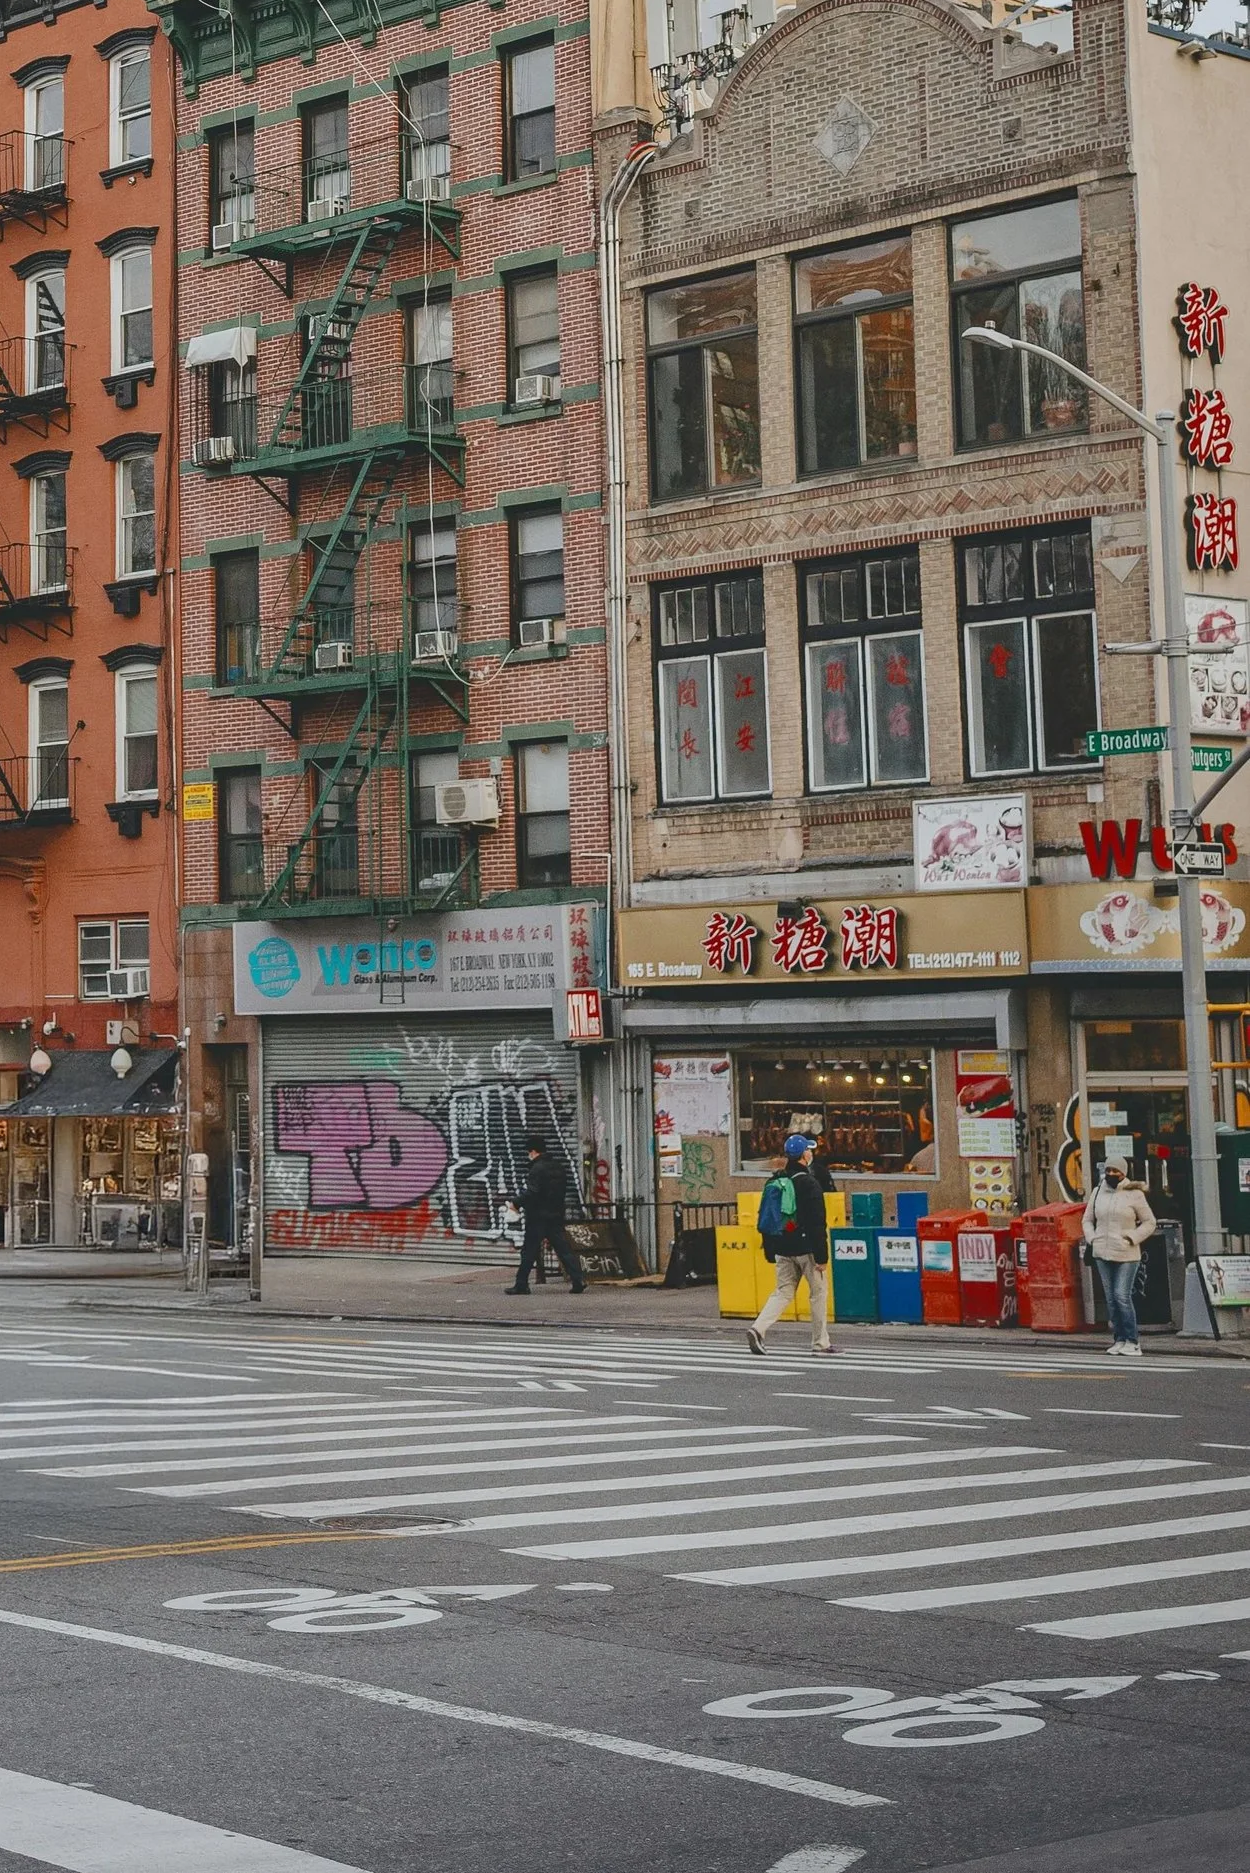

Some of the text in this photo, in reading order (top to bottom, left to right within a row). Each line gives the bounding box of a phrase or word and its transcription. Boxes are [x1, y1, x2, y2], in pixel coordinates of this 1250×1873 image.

[1089, 730, 1167, 752] E Broadway
[1191, 747, 1223, 771] Rutgers
[1180, 853, 1220, 867] ONE WAY
[354, 974, 373, 985] Glass
[627, 964, 644, 978] 165
[658, 962, 703, 980] Broadway
[568, 993, 589, 1037] ATM
[959, 1237, 992, 1260] INDY
